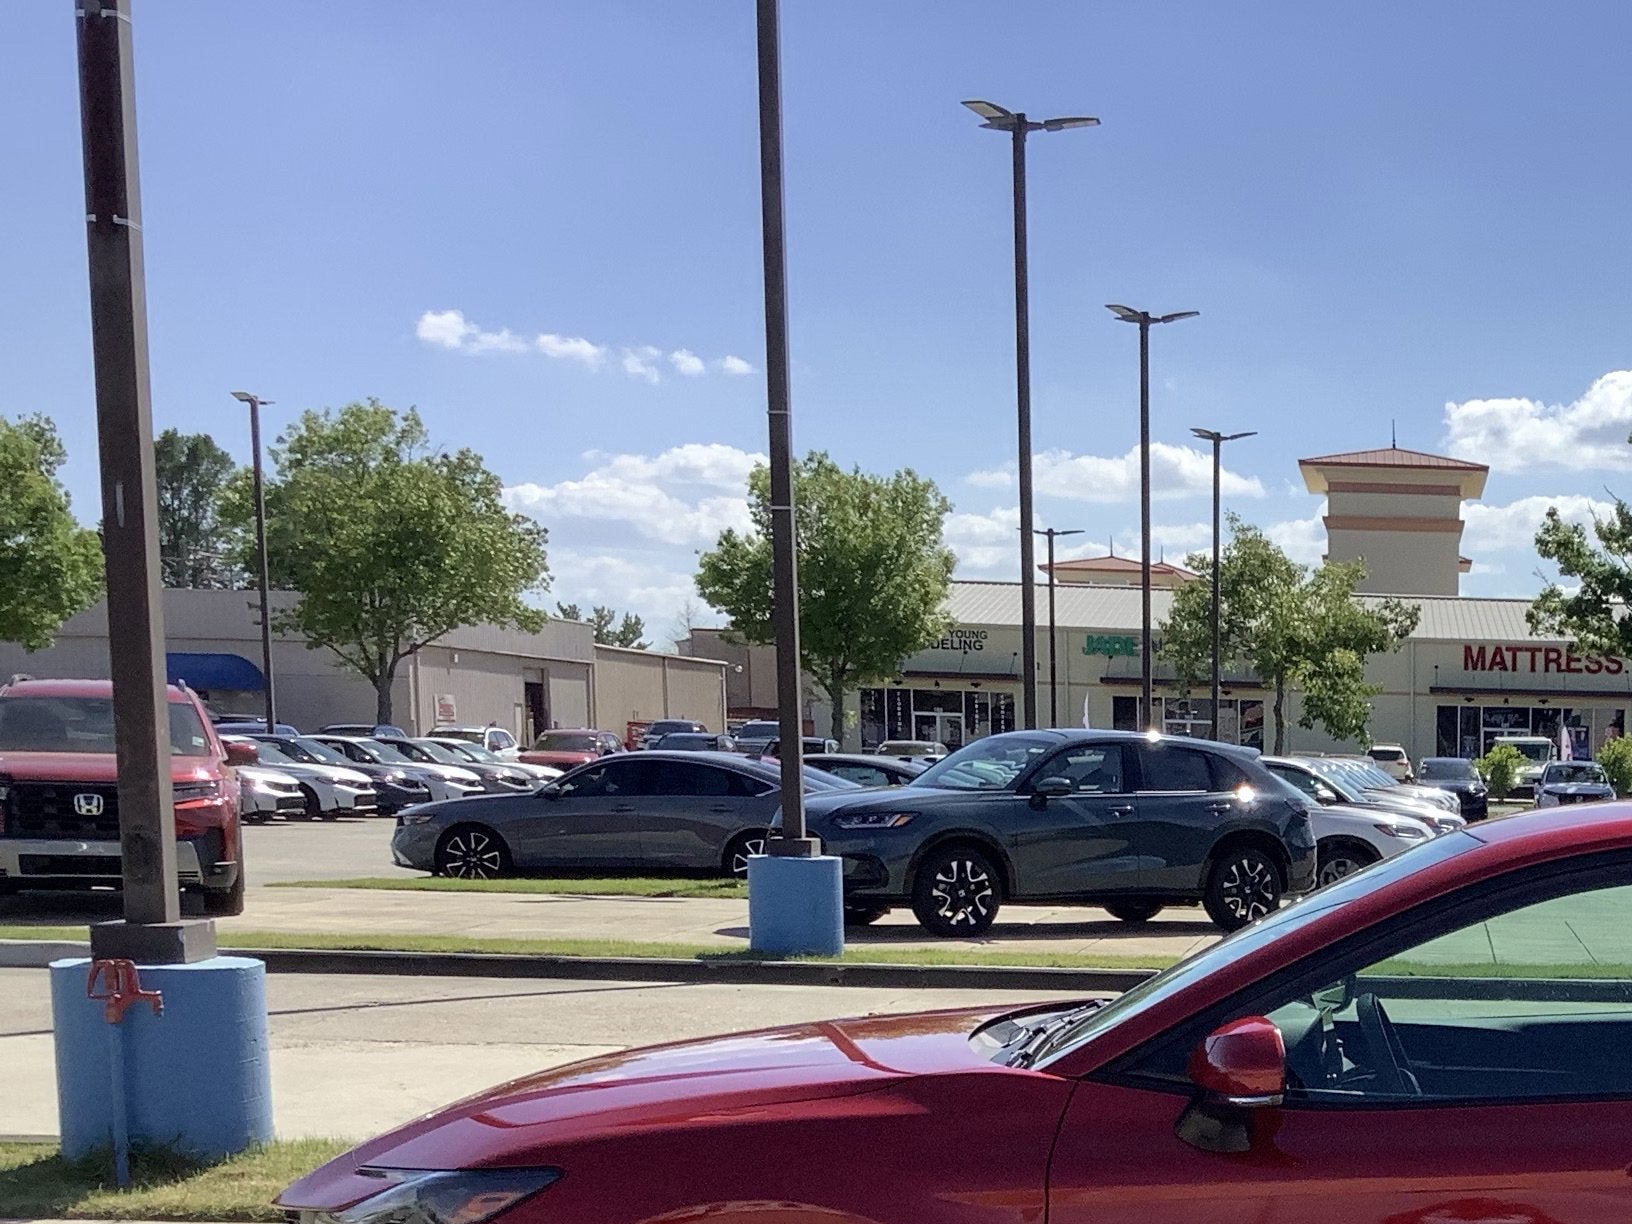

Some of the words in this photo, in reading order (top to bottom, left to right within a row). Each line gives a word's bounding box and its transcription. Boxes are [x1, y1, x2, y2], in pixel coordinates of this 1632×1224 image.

[949, 630, 988, 640] YOUNG
[930, 639, 984, 651] DELING
[1463, 645, 1624, 675] MATTRESS
